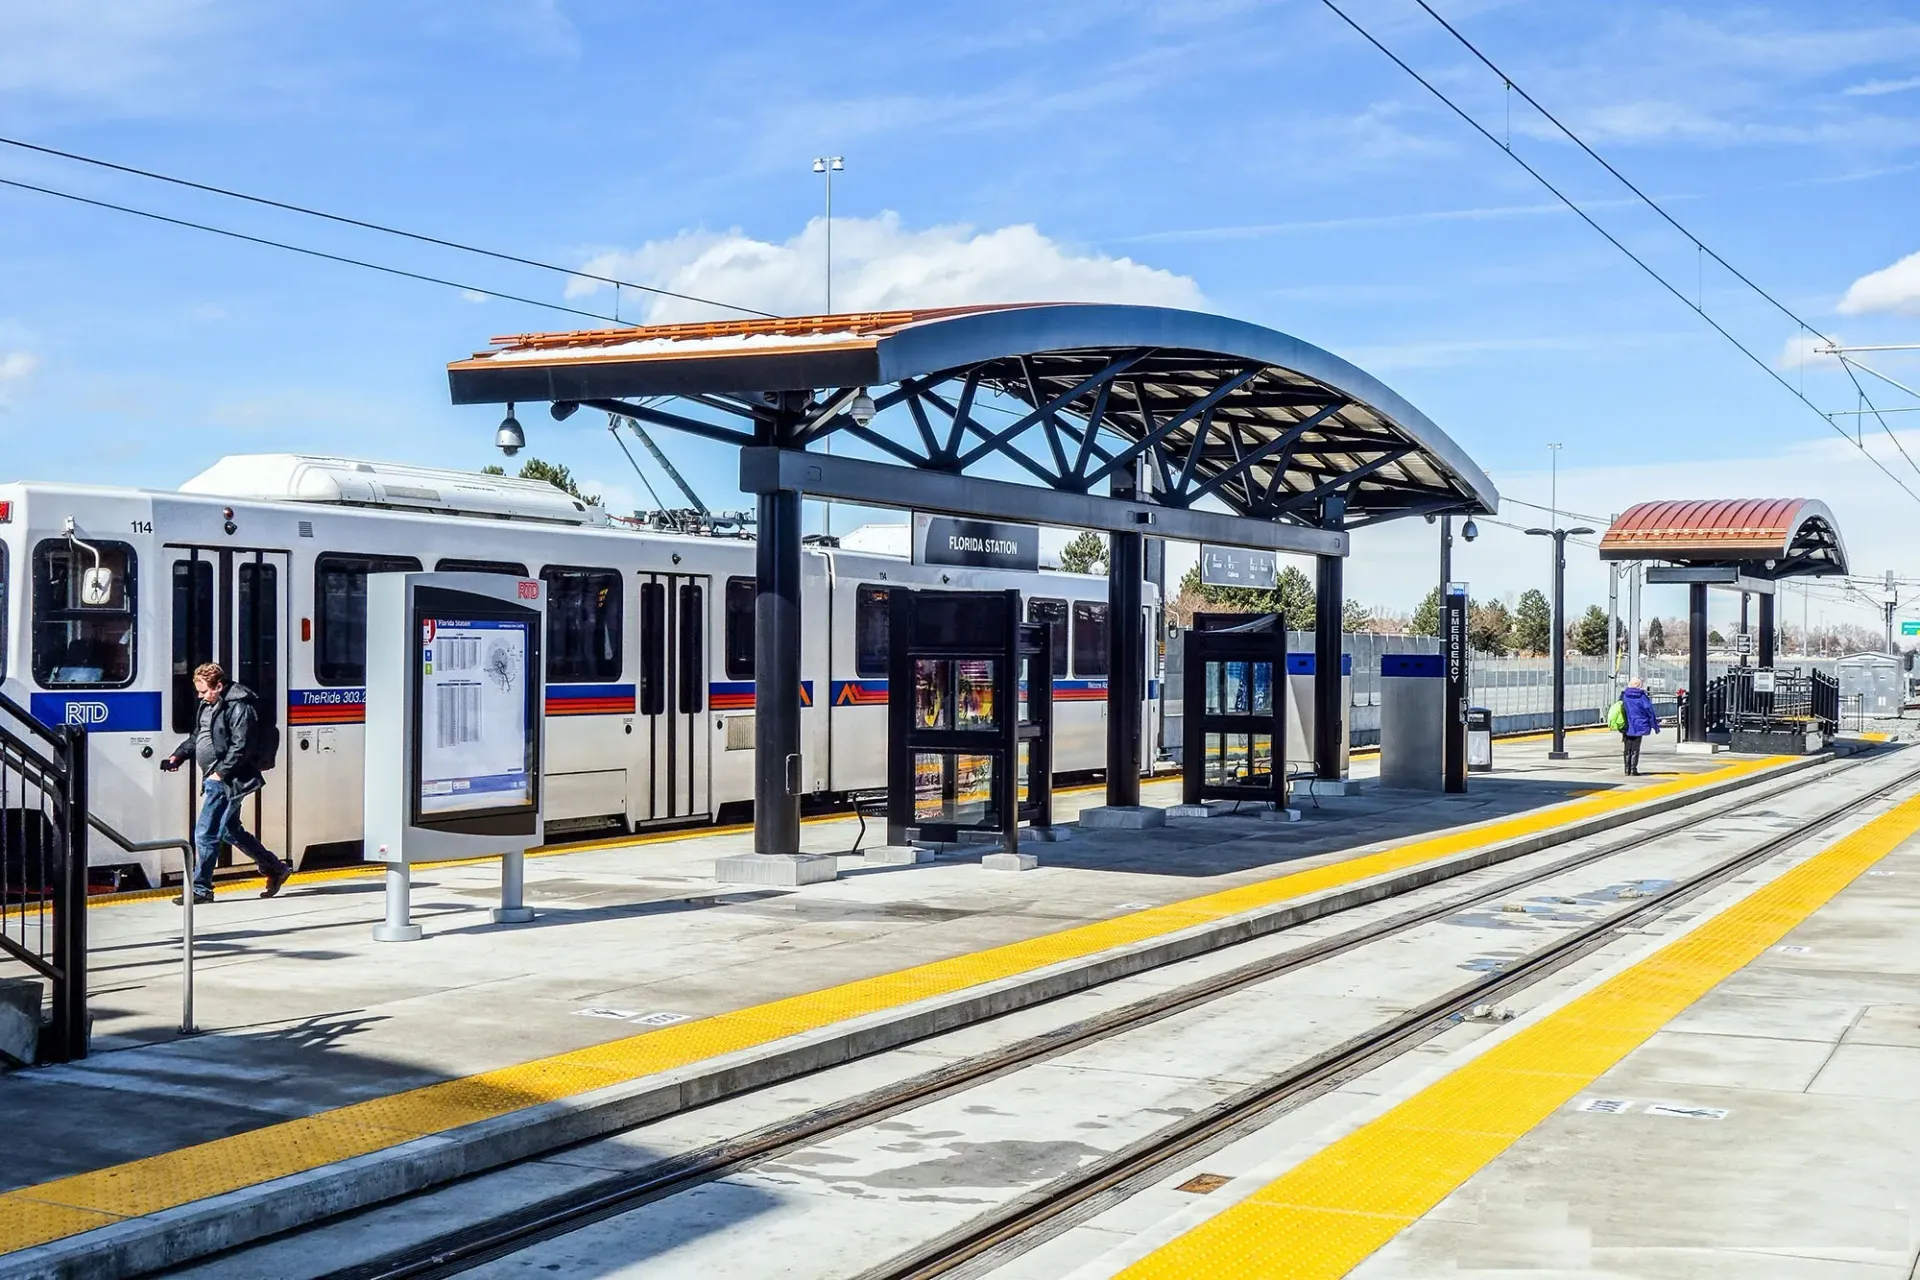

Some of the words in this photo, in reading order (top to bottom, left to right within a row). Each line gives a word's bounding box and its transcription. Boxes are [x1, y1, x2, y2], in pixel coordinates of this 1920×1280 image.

[131, 520, 153, 533] 114
[949, 535, 984, 552] FLORIDA
[985, 539, 1018, 554] STATION
[518, 581, 539, 599] RTD
[1451, 609, 1460, 683] EMERGENCY
[303, 691, 341, 704] TheRide
[65, 702, 109, 724] RTD
